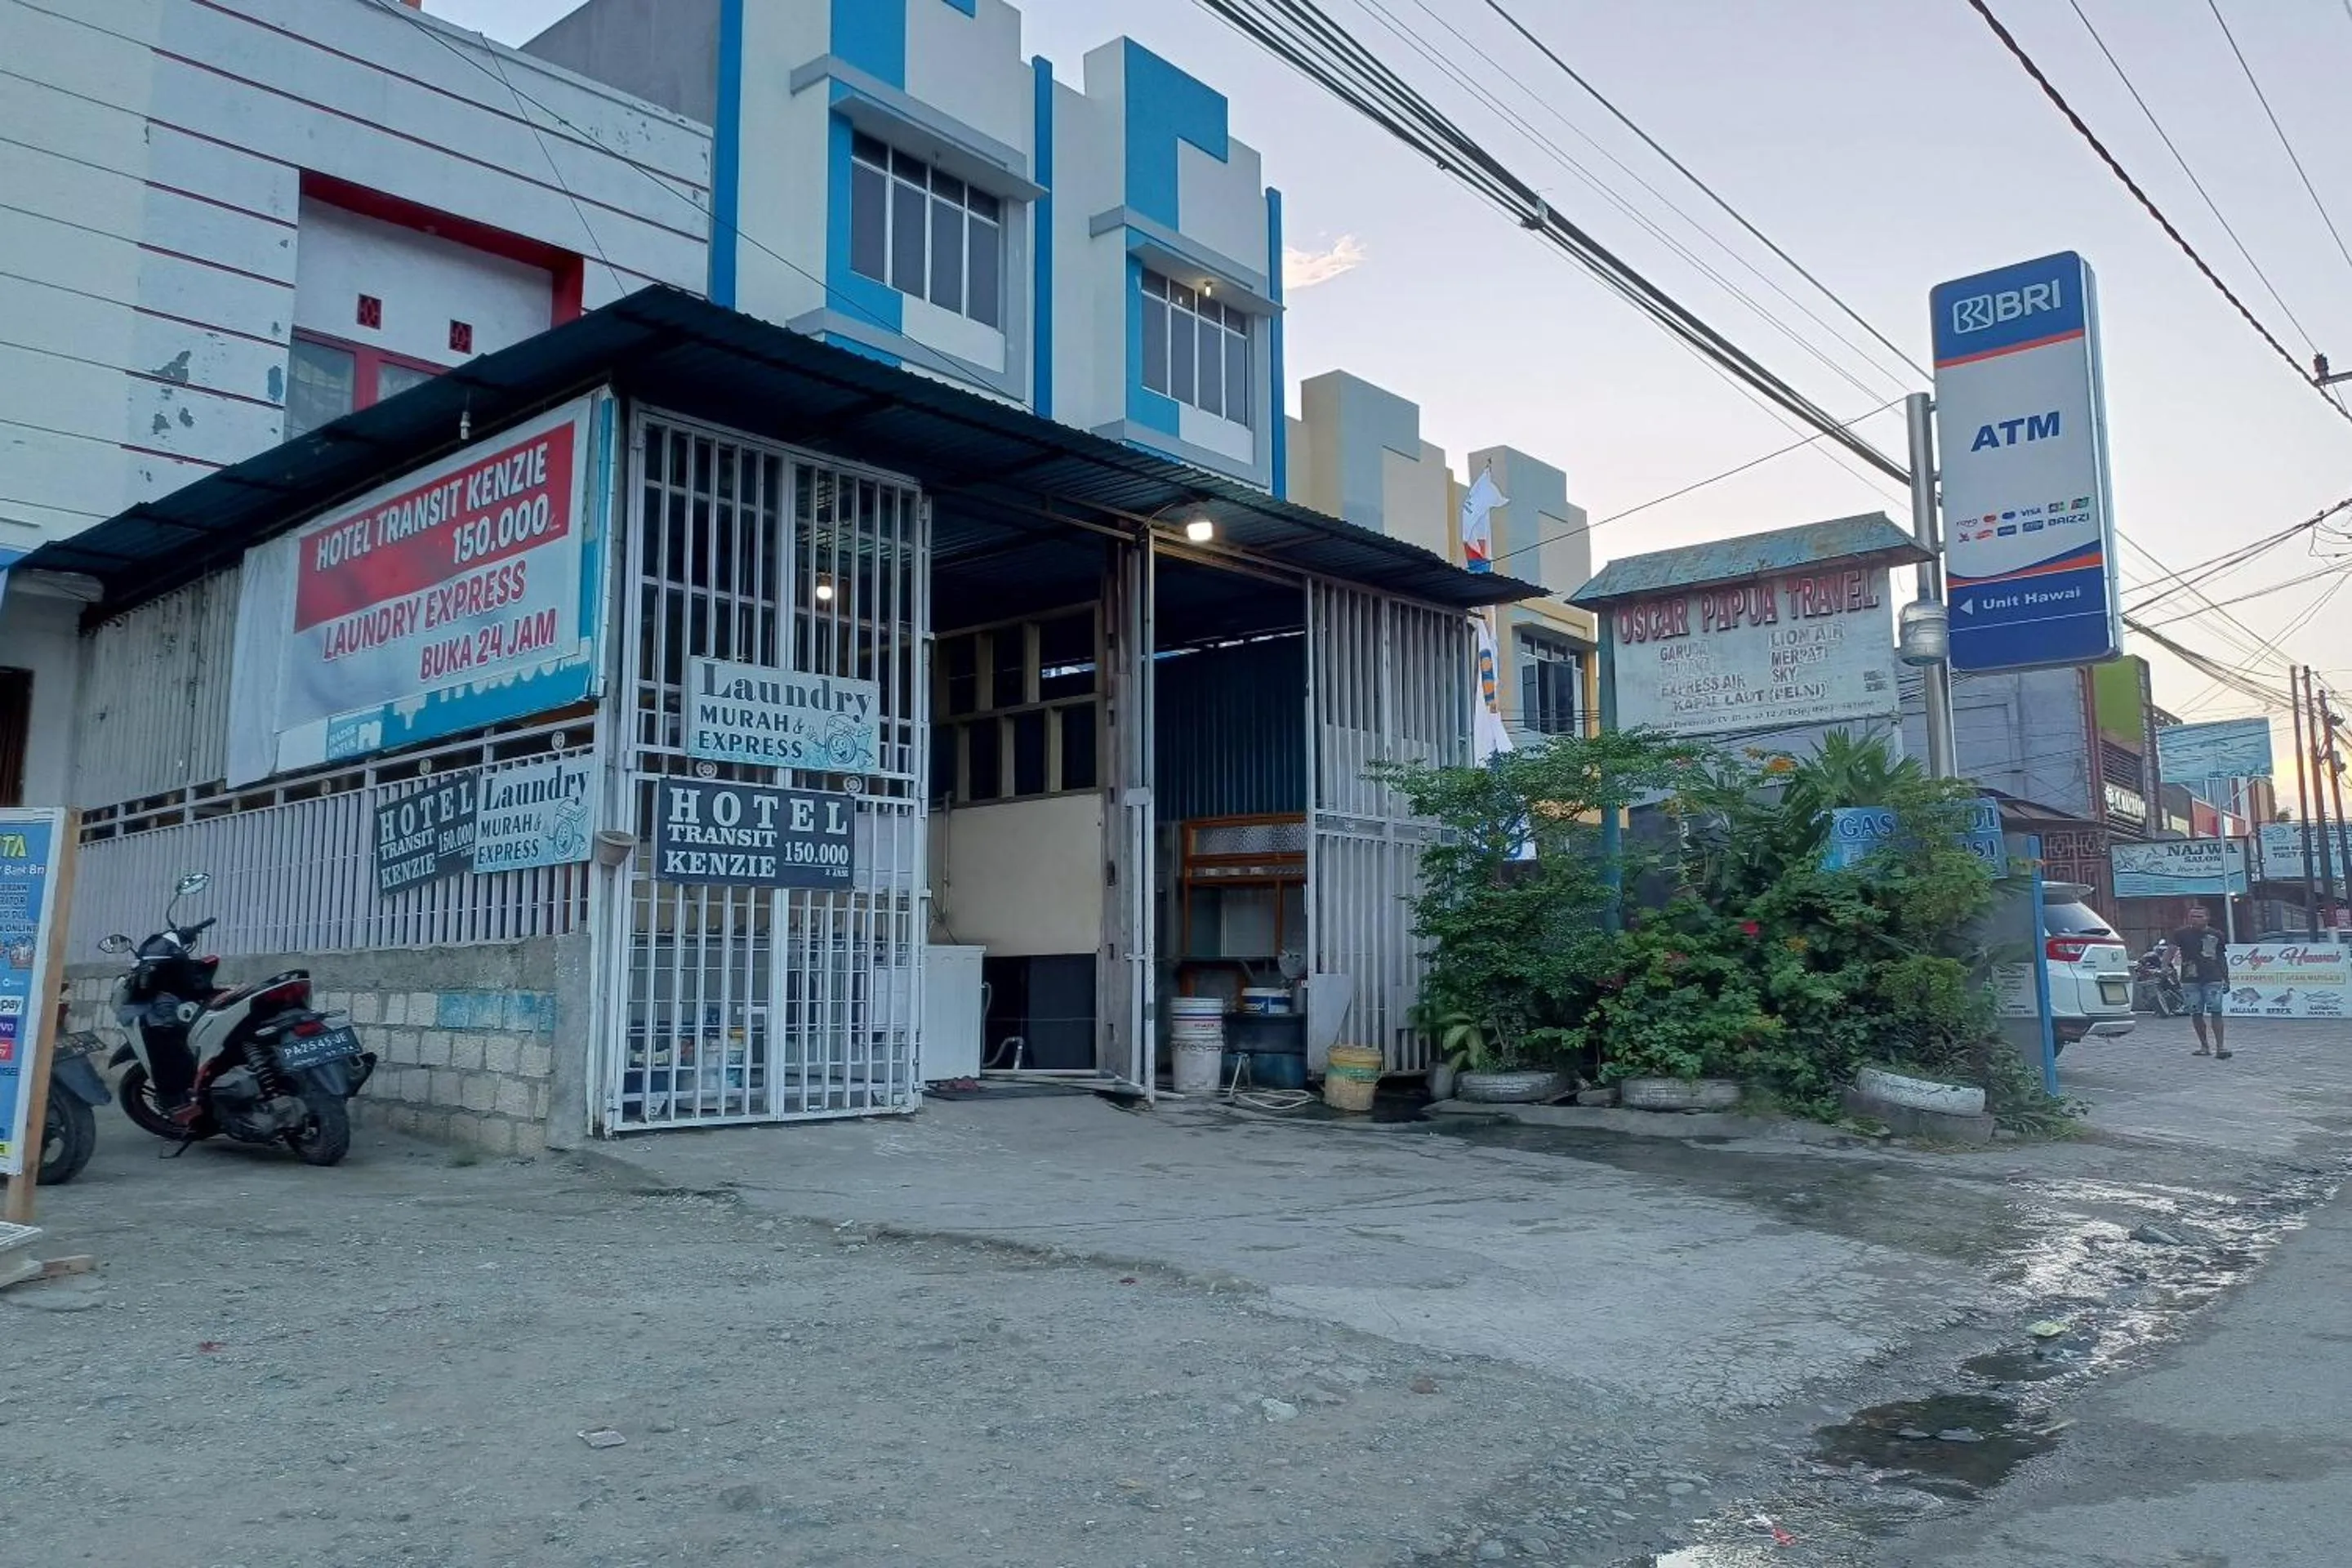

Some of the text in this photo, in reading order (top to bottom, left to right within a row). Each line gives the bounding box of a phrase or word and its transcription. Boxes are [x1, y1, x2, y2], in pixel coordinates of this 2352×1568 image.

[1996, 278, 2061, 323] BRI
[1971, 411, 2060, 452] ATM
[317, 443, 548, 571] HOTEL TRANSIT KENZIE
[323, 559, 526, 661] LAUNDRY EXPRESS
[1617, 569, 1878, 644] OSCAR PAPUA TRAVEL
[1982, 586, 2081, 609] Unit Hawai
[421, 608, 556, 680] BUKA 24 JAM
[1772, 666, 1796, 683] SKY
[700, 663, 872, 724] Laundry
[700, 705, 788, 733] MURAH
[698, 730, 802, 758] EXPRESS
[483, 765, 590, 811] Laundry
[379, 781, 474, 844] HOTEL
[668, 787, 848, 835] HOTEL
[480, 813, 532, 838] MURAH
[667, 823, 778, 848] TRANSIT
[1838, 813, 1895, 838] GAS
[0, 834, 27, 858] TA
[380, 827, 435, 861] TRANSIT
[478, 839, 539, 864] EXPRESS
[785, 841, 849, 865] 150.000
[2167, 843, 2238, 856] NAJWA
[381, 853, 435, 889] KENZIE
[665, 850, 776, 877] KENZIE
[2184, 855, 2221, 863] SALON
